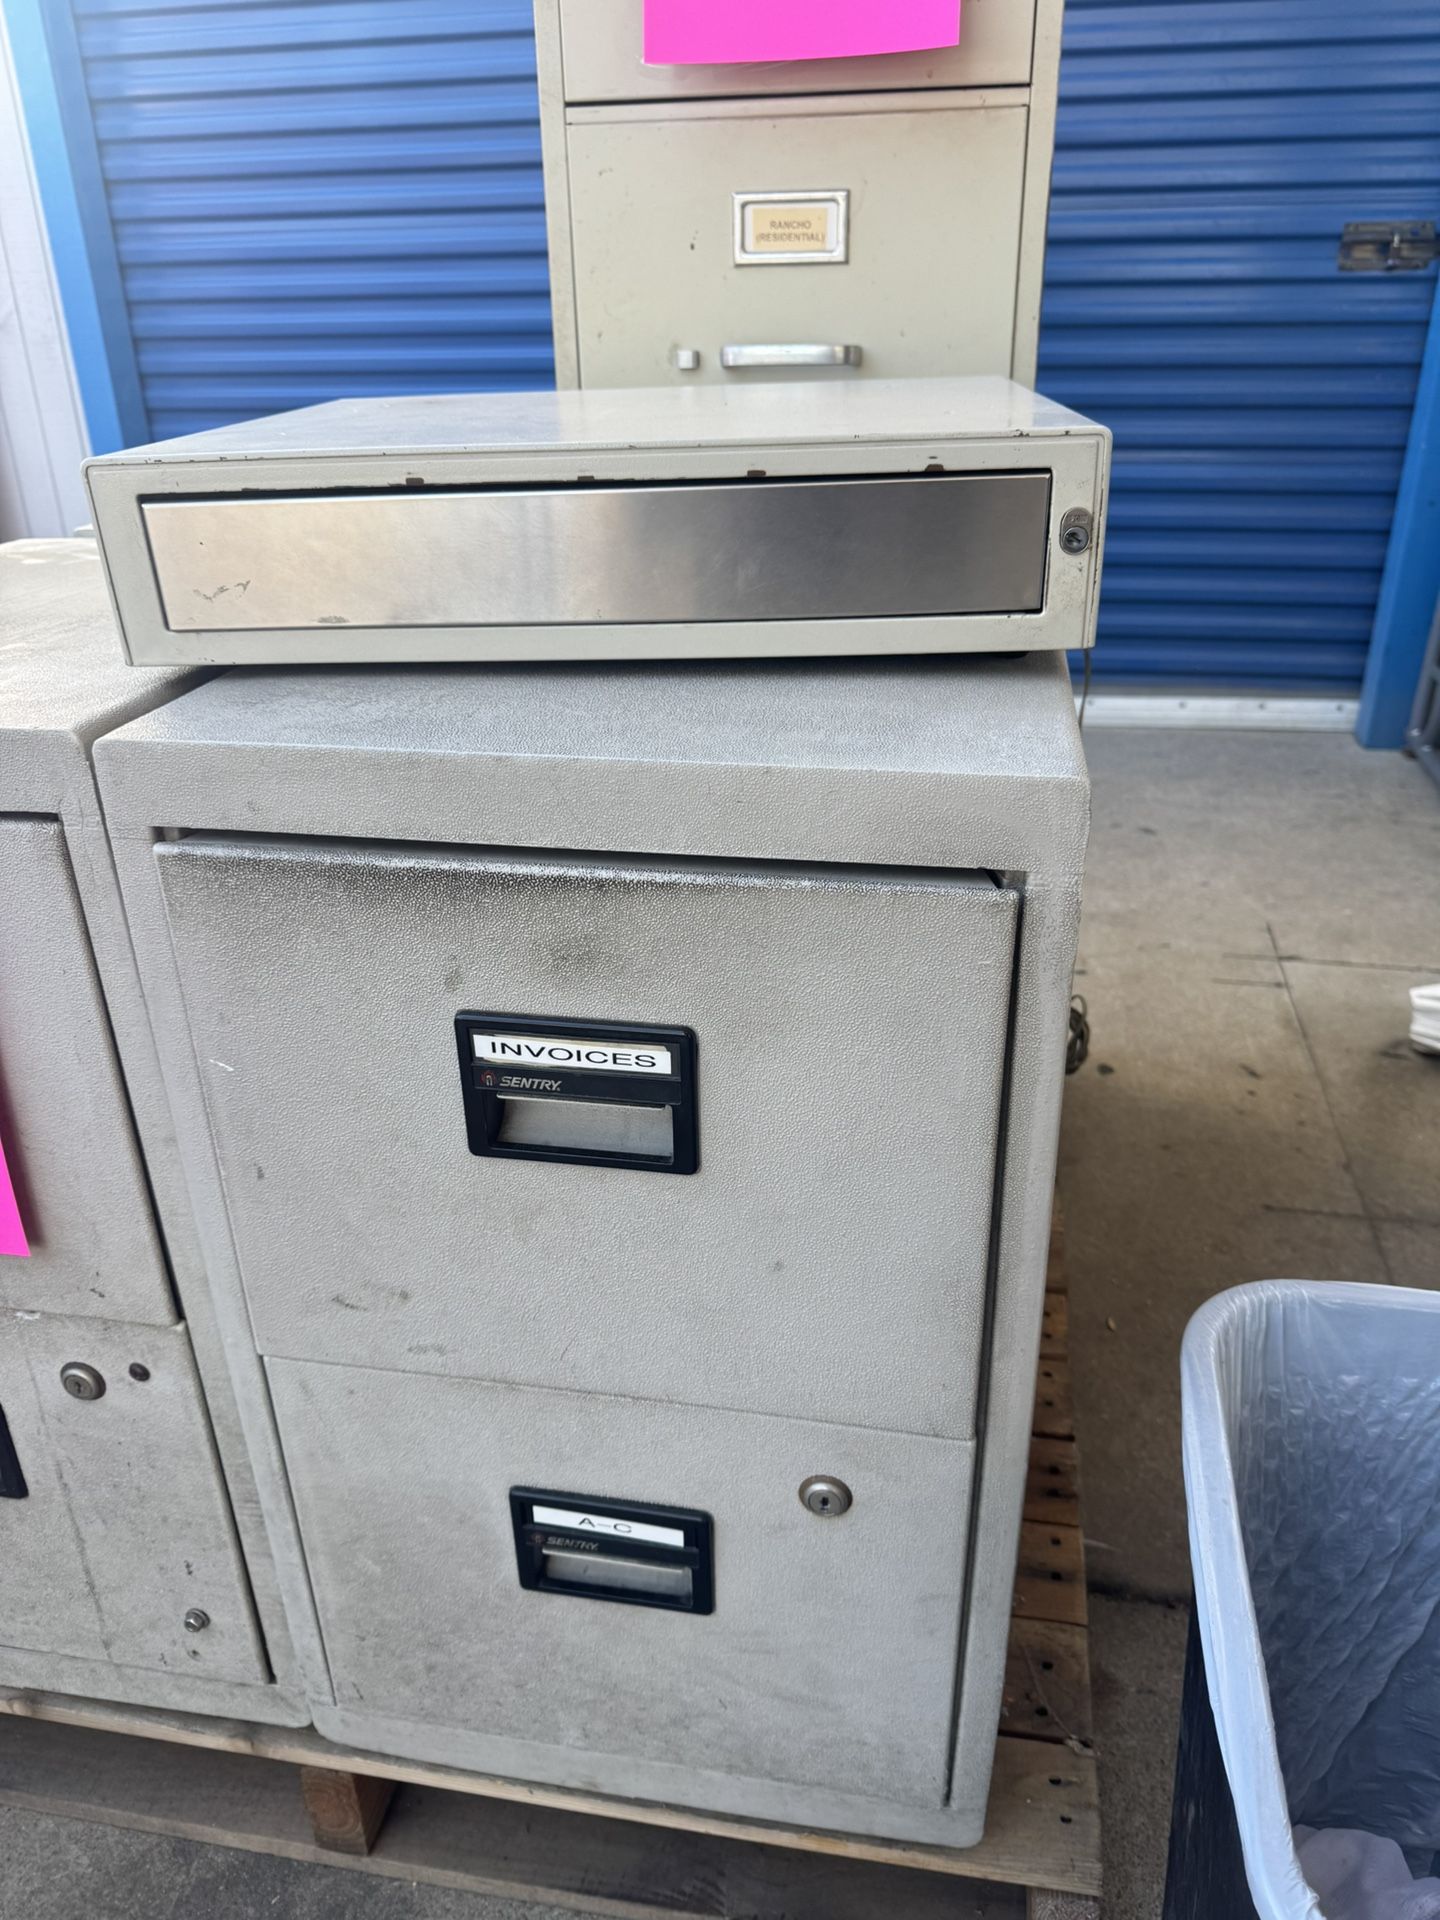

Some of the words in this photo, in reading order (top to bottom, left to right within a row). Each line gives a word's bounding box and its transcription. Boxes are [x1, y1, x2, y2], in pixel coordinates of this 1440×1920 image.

[770, 220, 812, 230] RANCHO
[757, 232, 826, 243] (RESIDENTIAL)
[492, 1042, 656, 1068] INVOICES
[499, 1076, 561, 1091] SENTRY
[579, 1517, 632, 1533] A-C
